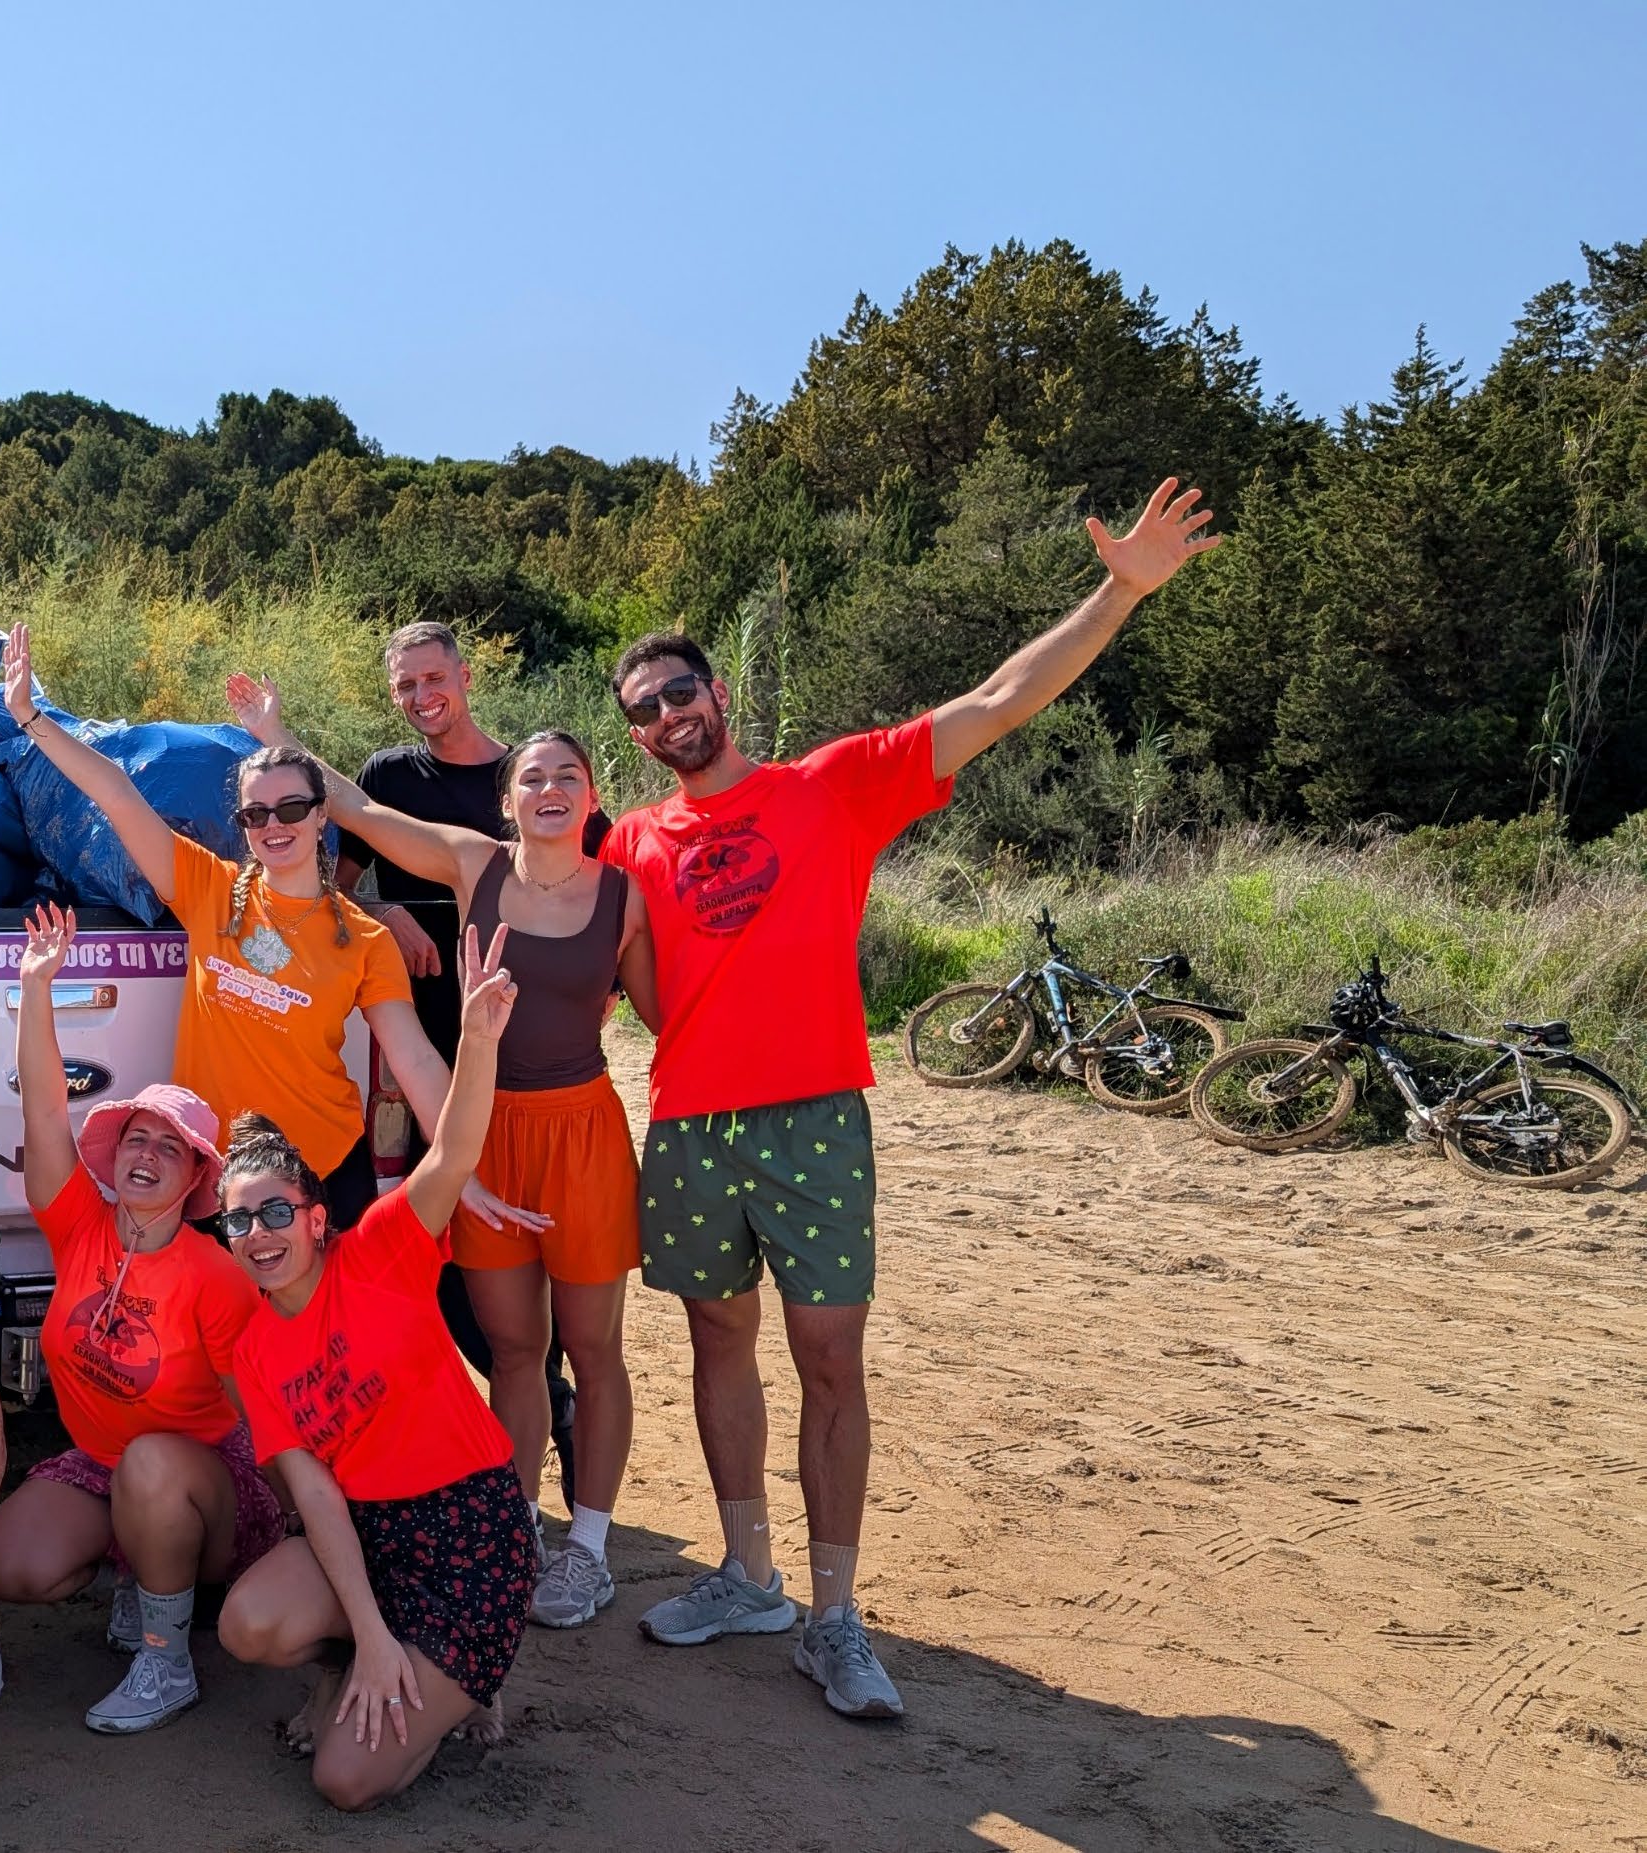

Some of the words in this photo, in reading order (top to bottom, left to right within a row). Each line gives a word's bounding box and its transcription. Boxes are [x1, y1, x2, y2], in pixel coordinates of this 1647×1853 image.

[117, 942, 147, 969] τη
[218, 977, 249, 995] your
[253, 991, 288, 1011] hood
